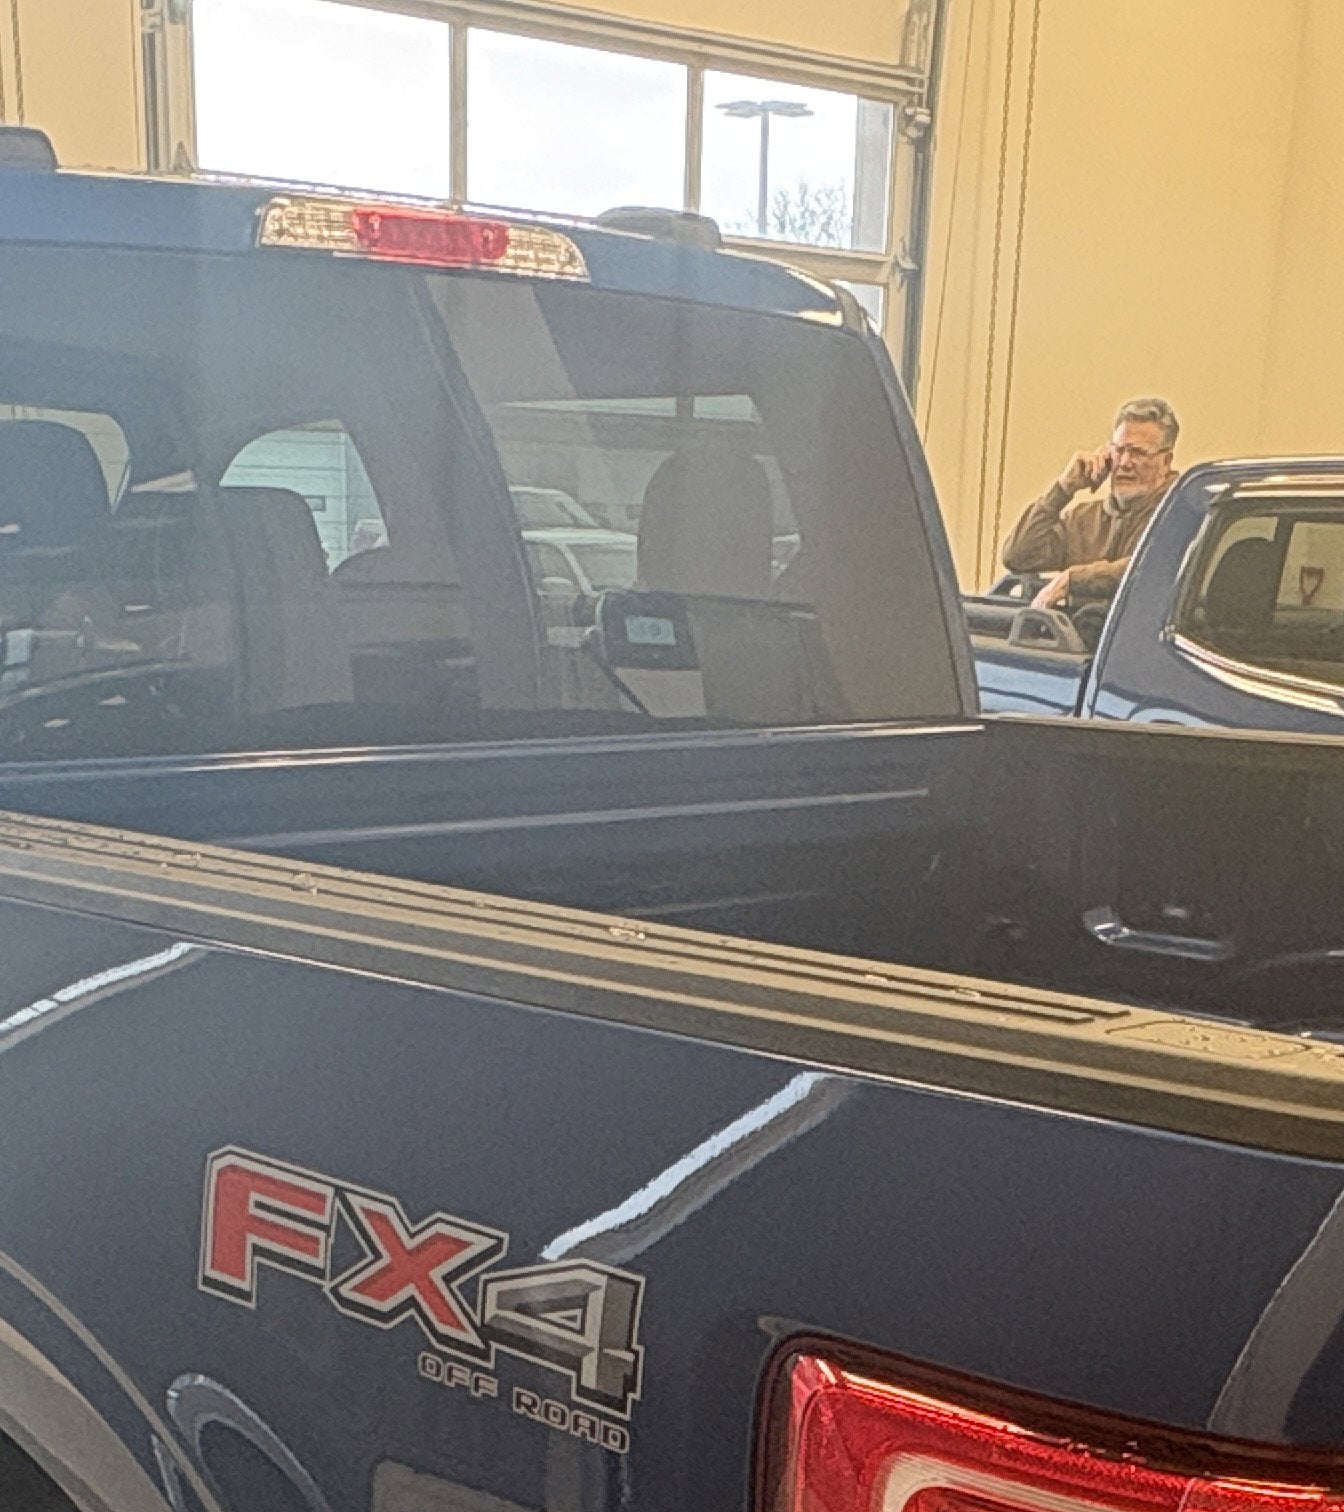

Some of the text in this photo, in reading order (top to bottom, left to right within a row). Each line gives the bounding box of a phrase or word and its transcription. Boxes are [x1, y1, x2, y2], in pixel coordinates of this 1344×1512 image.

[198, 1144, 645, 1421] FX4
[418, 1351, 631, 1455] OFF ROAD
